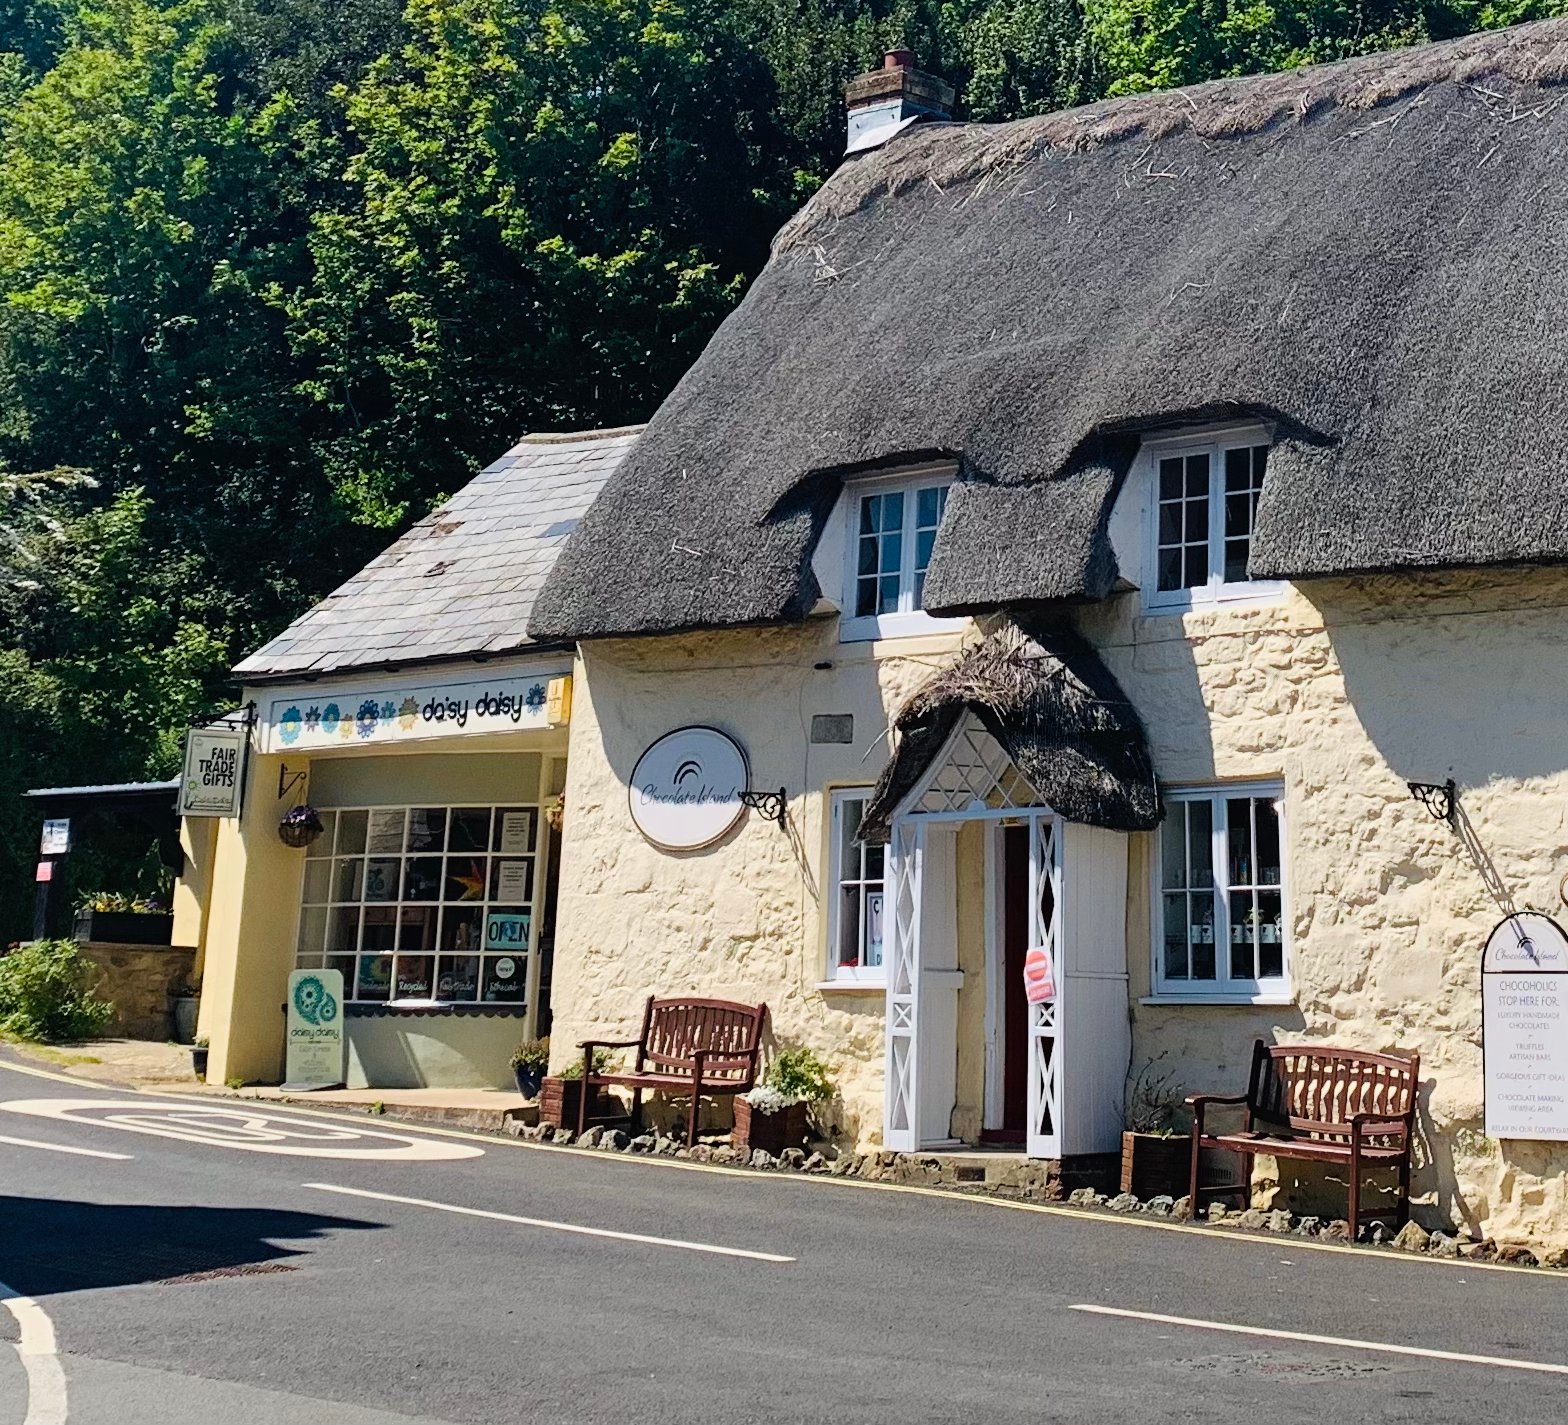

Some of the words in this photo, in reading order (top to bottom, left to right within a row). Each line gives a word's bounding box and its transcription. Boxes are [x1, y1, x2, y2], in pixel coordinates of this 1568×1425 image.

[422, 696, 469, 728] daisy
[475, 691, 523, 723] daisy
[211, 747, 236, 761] FAIR
[199, 759, 235, 775] TRADE
[203, 773, 234, 788] GIFTS
[640, 783, 696, 806] Chocolate
[696, 783, 736, 806] Island
[488, 920, 530, 943] OPEN
[1499, 980, 1557, 992] CHOCOHOLICS
[1498, 995, 1517, 1006] STOP
[1519, 995, 1539, 1006] HERE
[1497, 1011, 1521, 1019] LUXURY
[1522, 1011, 1560, 1019] HANDMADE
[1508, 1022, 1550, 1030] CHOCOLATES
[290, 1026, 314, 1040] daisy
[315, 1027, 340, 1040] daisy
[1515, 1043, 1545, 1051] TRUFFLES
[1508, 1053, 1535, 1061] ARTISAN
[1495, 1072, 1531, 1081] GORGEOUS
[1497, 1094, 1536, 1102] CHOCOLATE
[1536, 1095, 1565, 1103] MAKING
